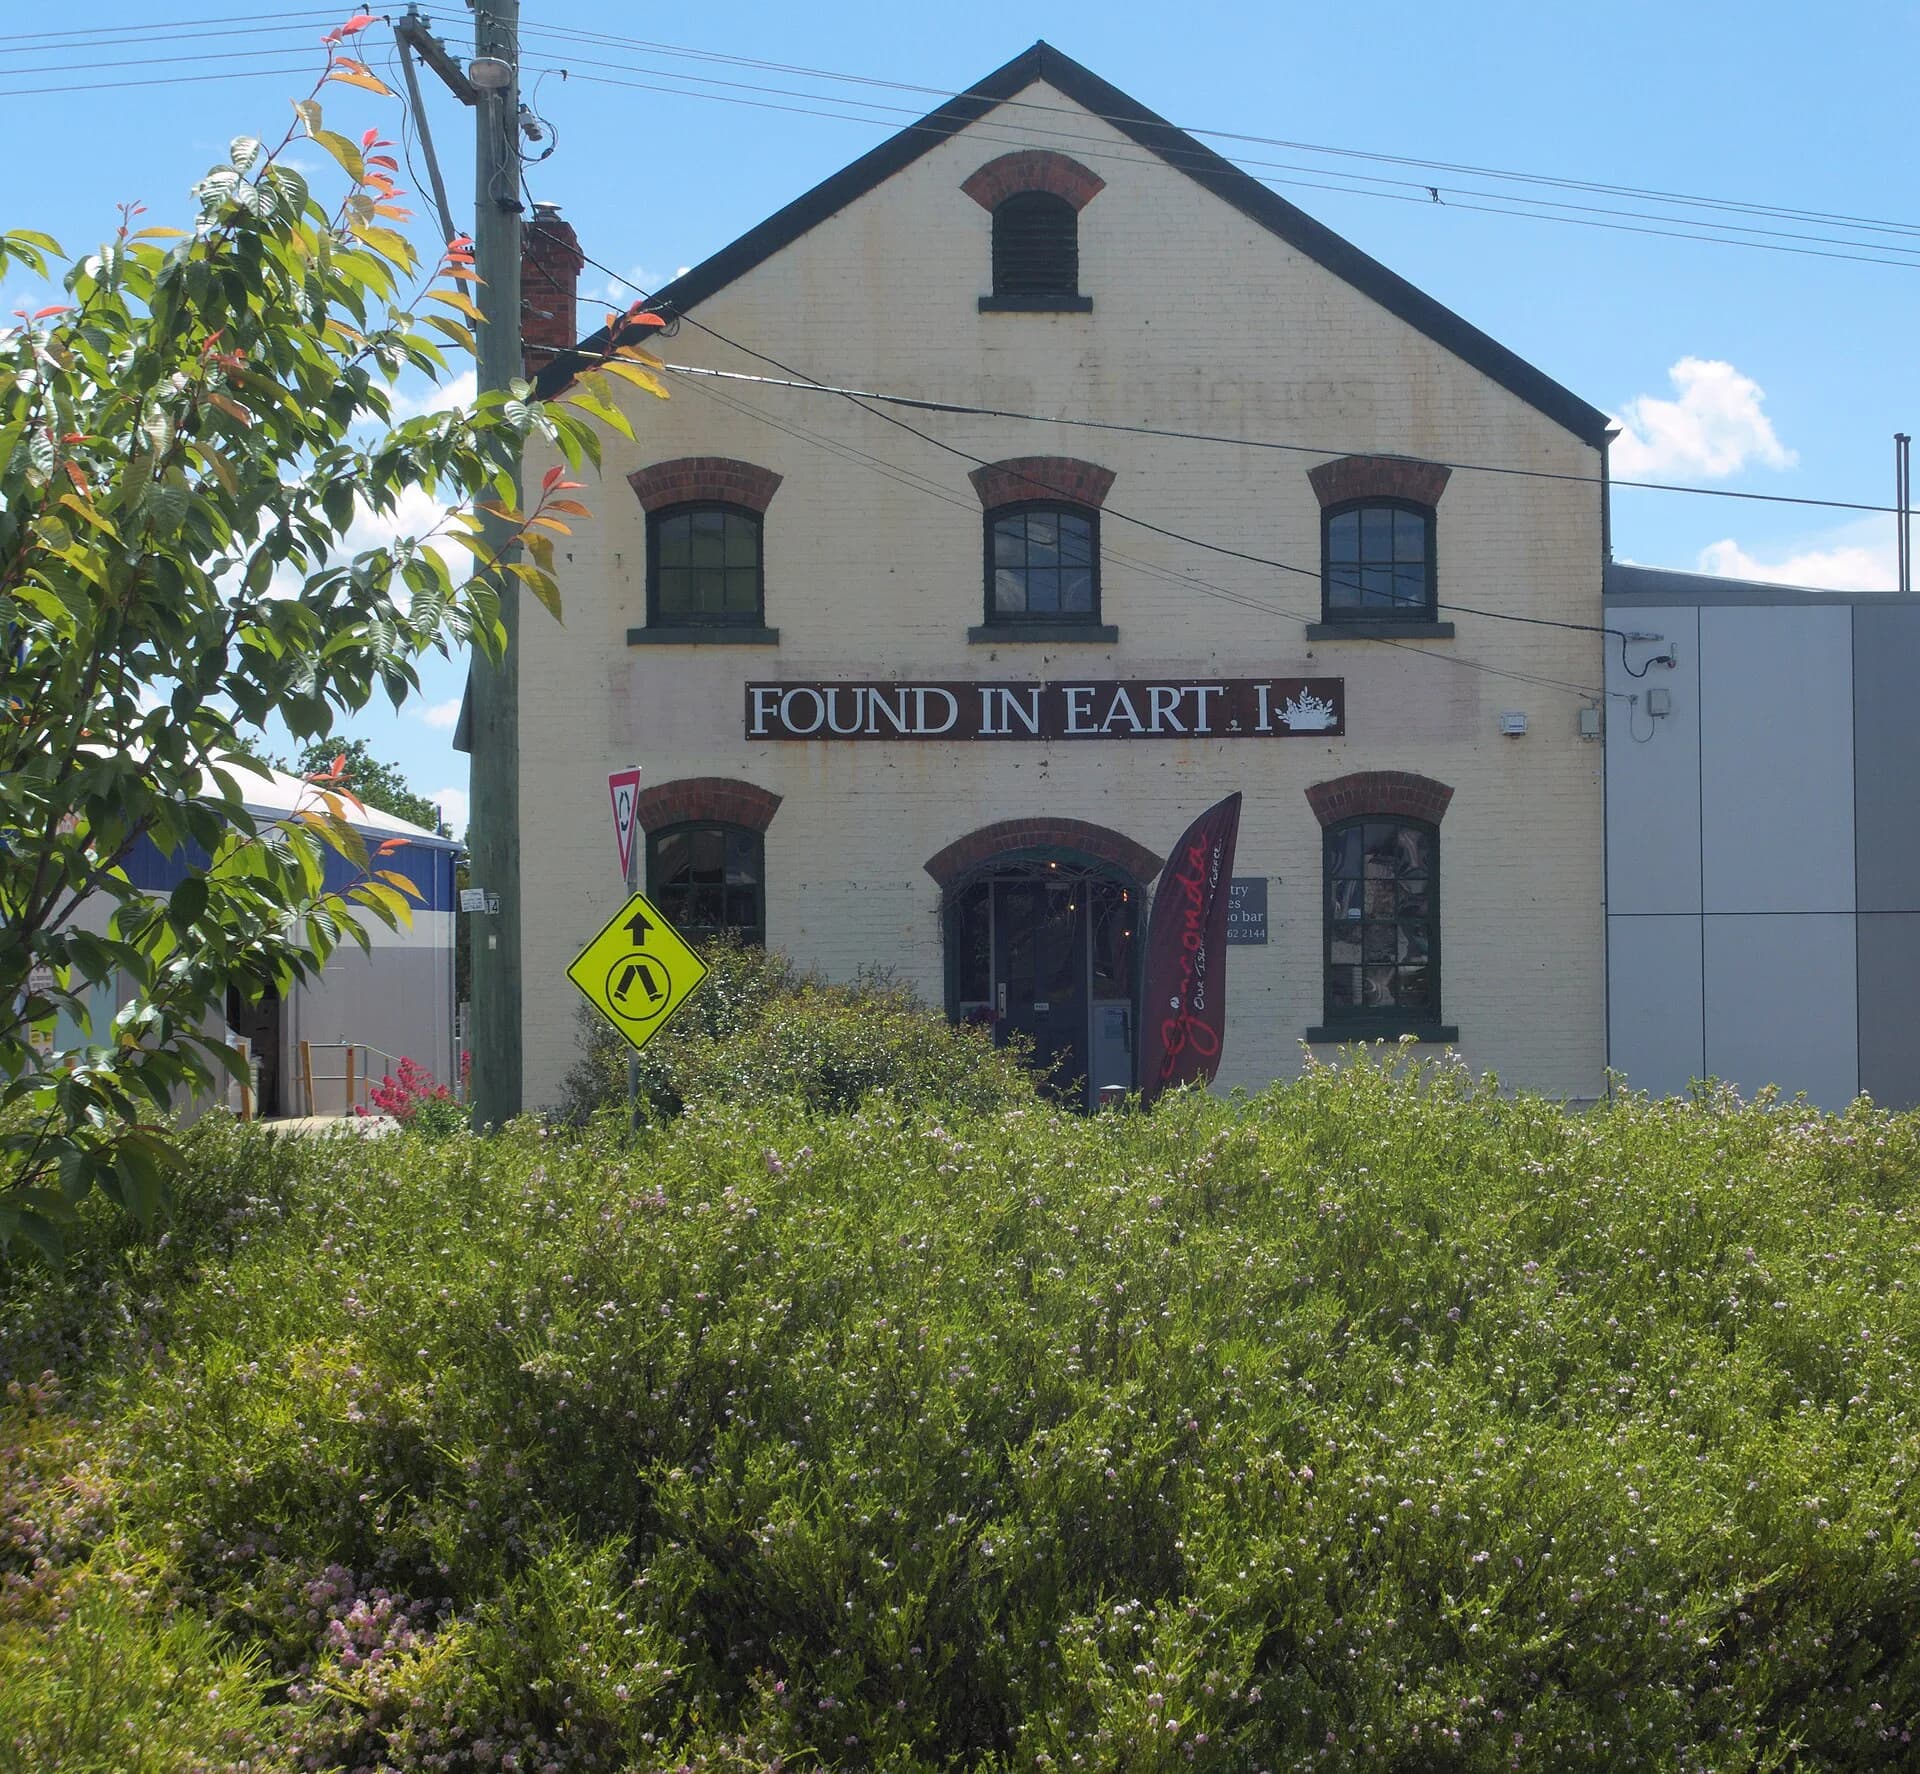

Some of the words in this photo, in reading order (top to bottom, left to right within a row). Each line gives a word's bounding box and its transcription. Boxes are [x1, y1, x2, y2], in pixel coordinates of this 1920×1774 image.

[748, 687, 960, 735] FOUND
[978, 687, 1040, 735] IN
[1242, 910, 1264, 922] bar
[1242, 929, 1265, 938] 2144
